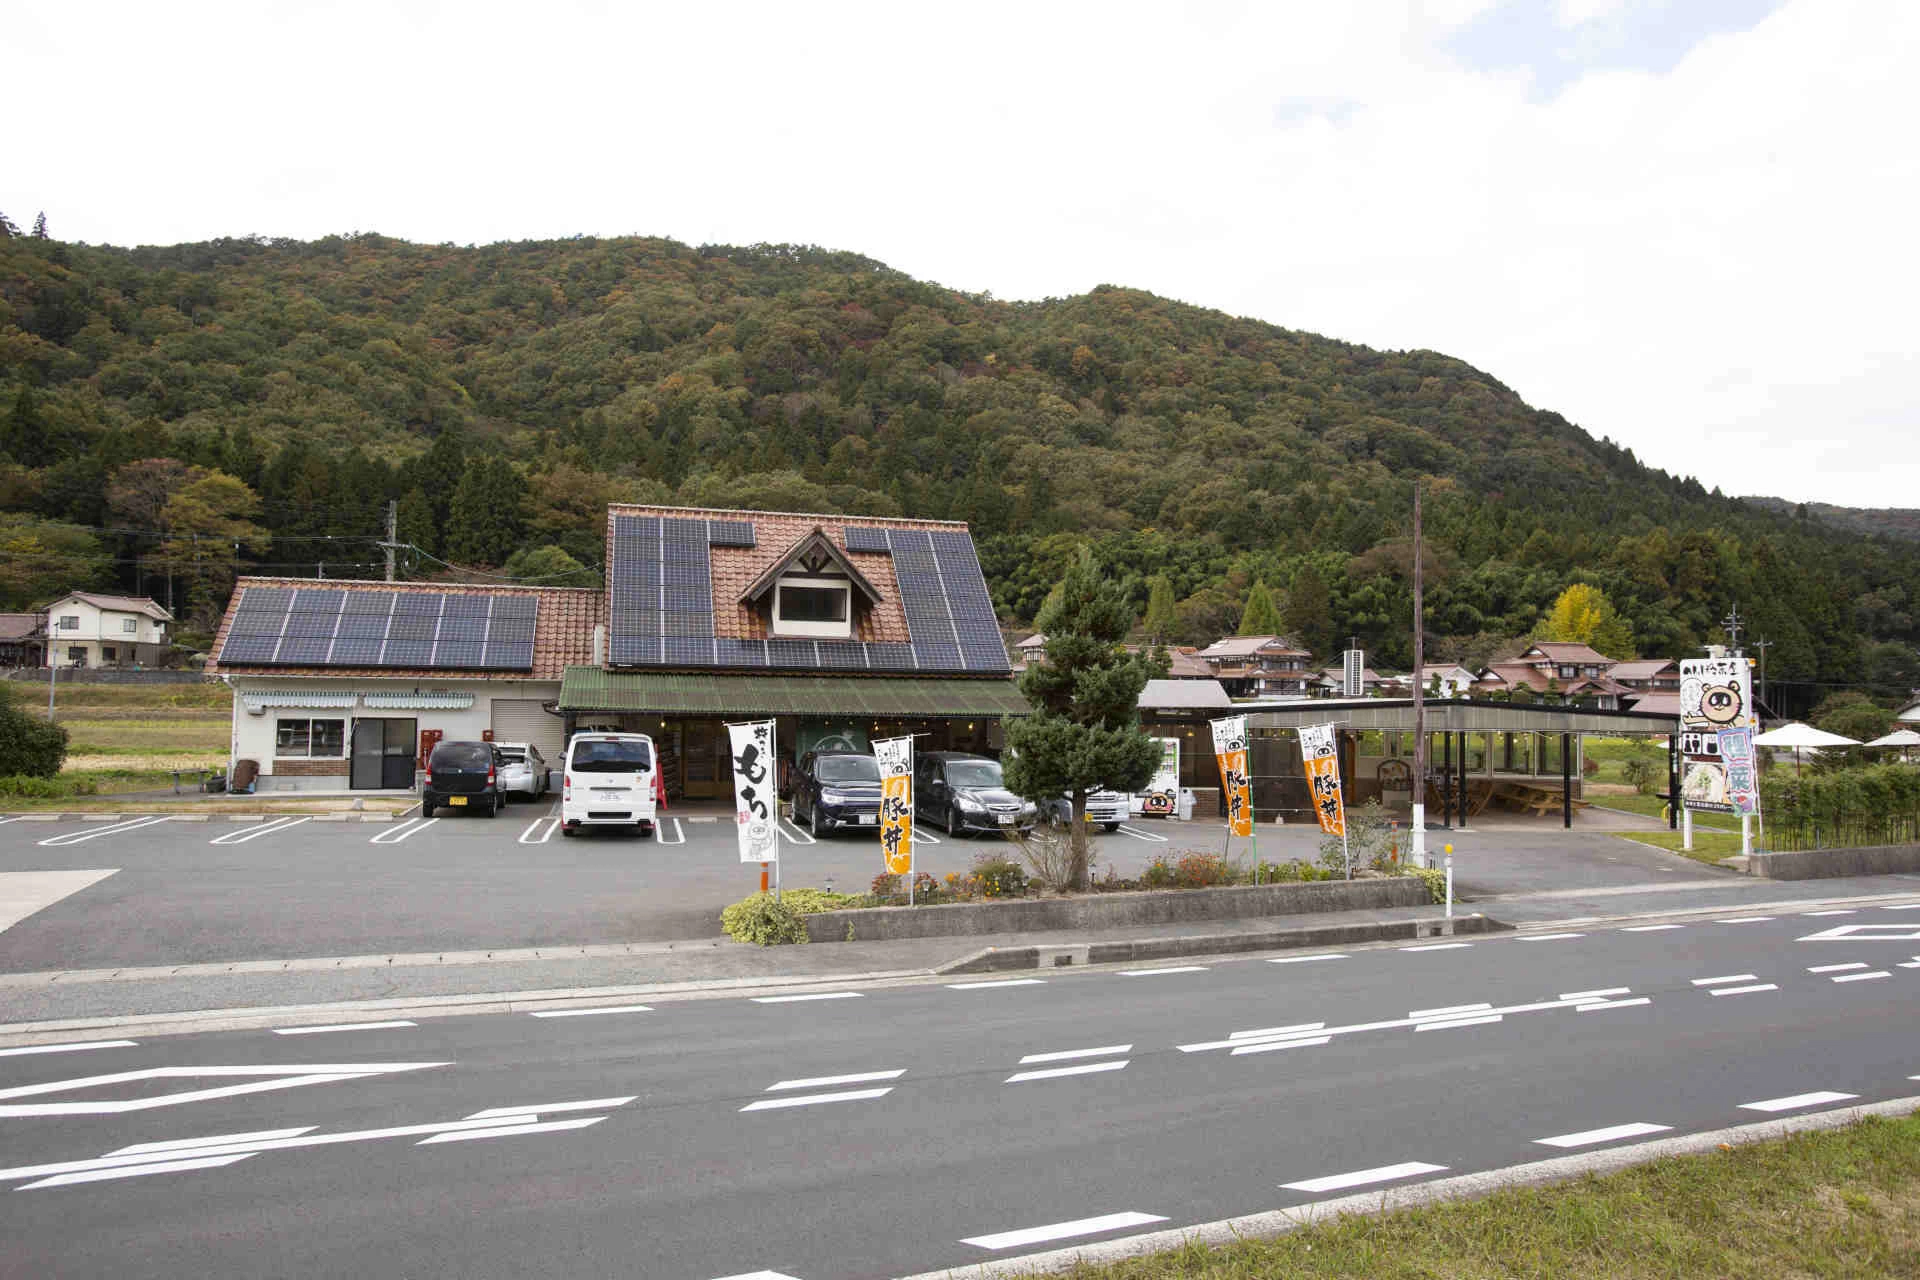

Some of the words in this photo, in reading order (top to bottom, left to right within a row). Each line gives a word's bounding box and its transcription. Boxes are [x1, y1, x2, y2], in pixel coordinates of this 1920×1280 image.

[734, 744, 767, 819] もち
[1313, 774, 1338, 821] 豚丼
[881, 797, 908, 855] 豚丼
